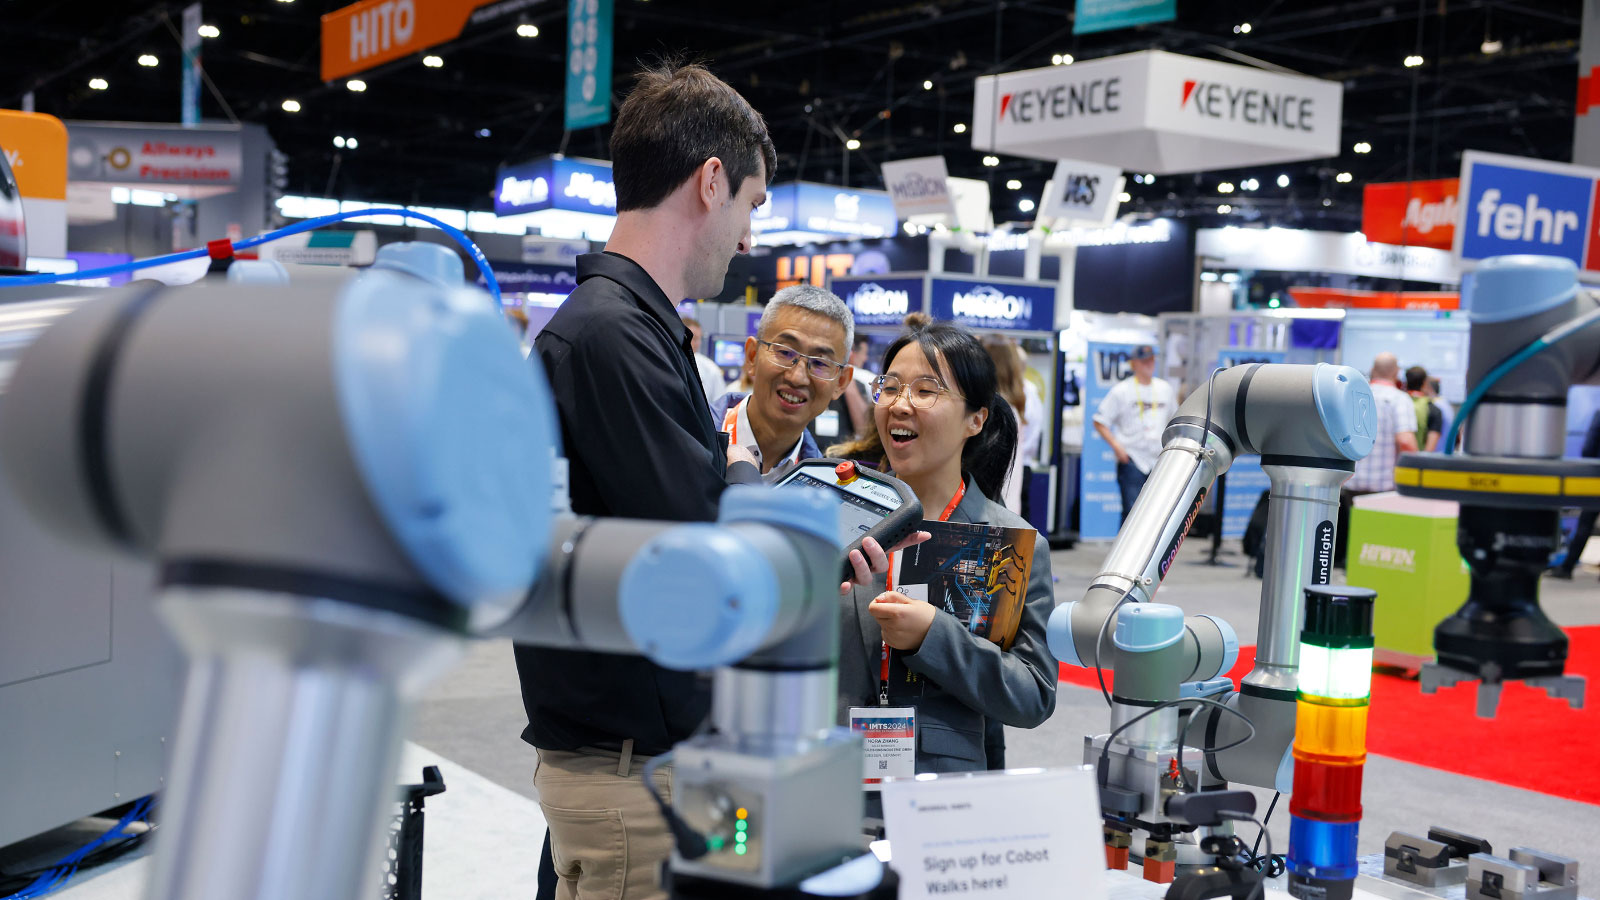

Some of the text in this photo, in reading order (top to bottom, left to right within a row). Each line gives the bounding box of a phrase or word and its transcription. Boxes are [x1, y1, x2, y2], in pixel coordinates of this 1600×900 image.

[350, 0, 417, 62] HITO
[1000, 78, 1121, 124] KEYENCE
[1181, 80, 1314, 132] KEYENCE
[139, 165, 231, 181] Precision
[141, 141, 216, 159] Allways
[1477, 188, 1579, 244] fehr
[1319, 527, 1332, 585] undlight
[923, 849, 1049, 874] Sign up for Cobot
[926, 878, 968, 895] Walks
